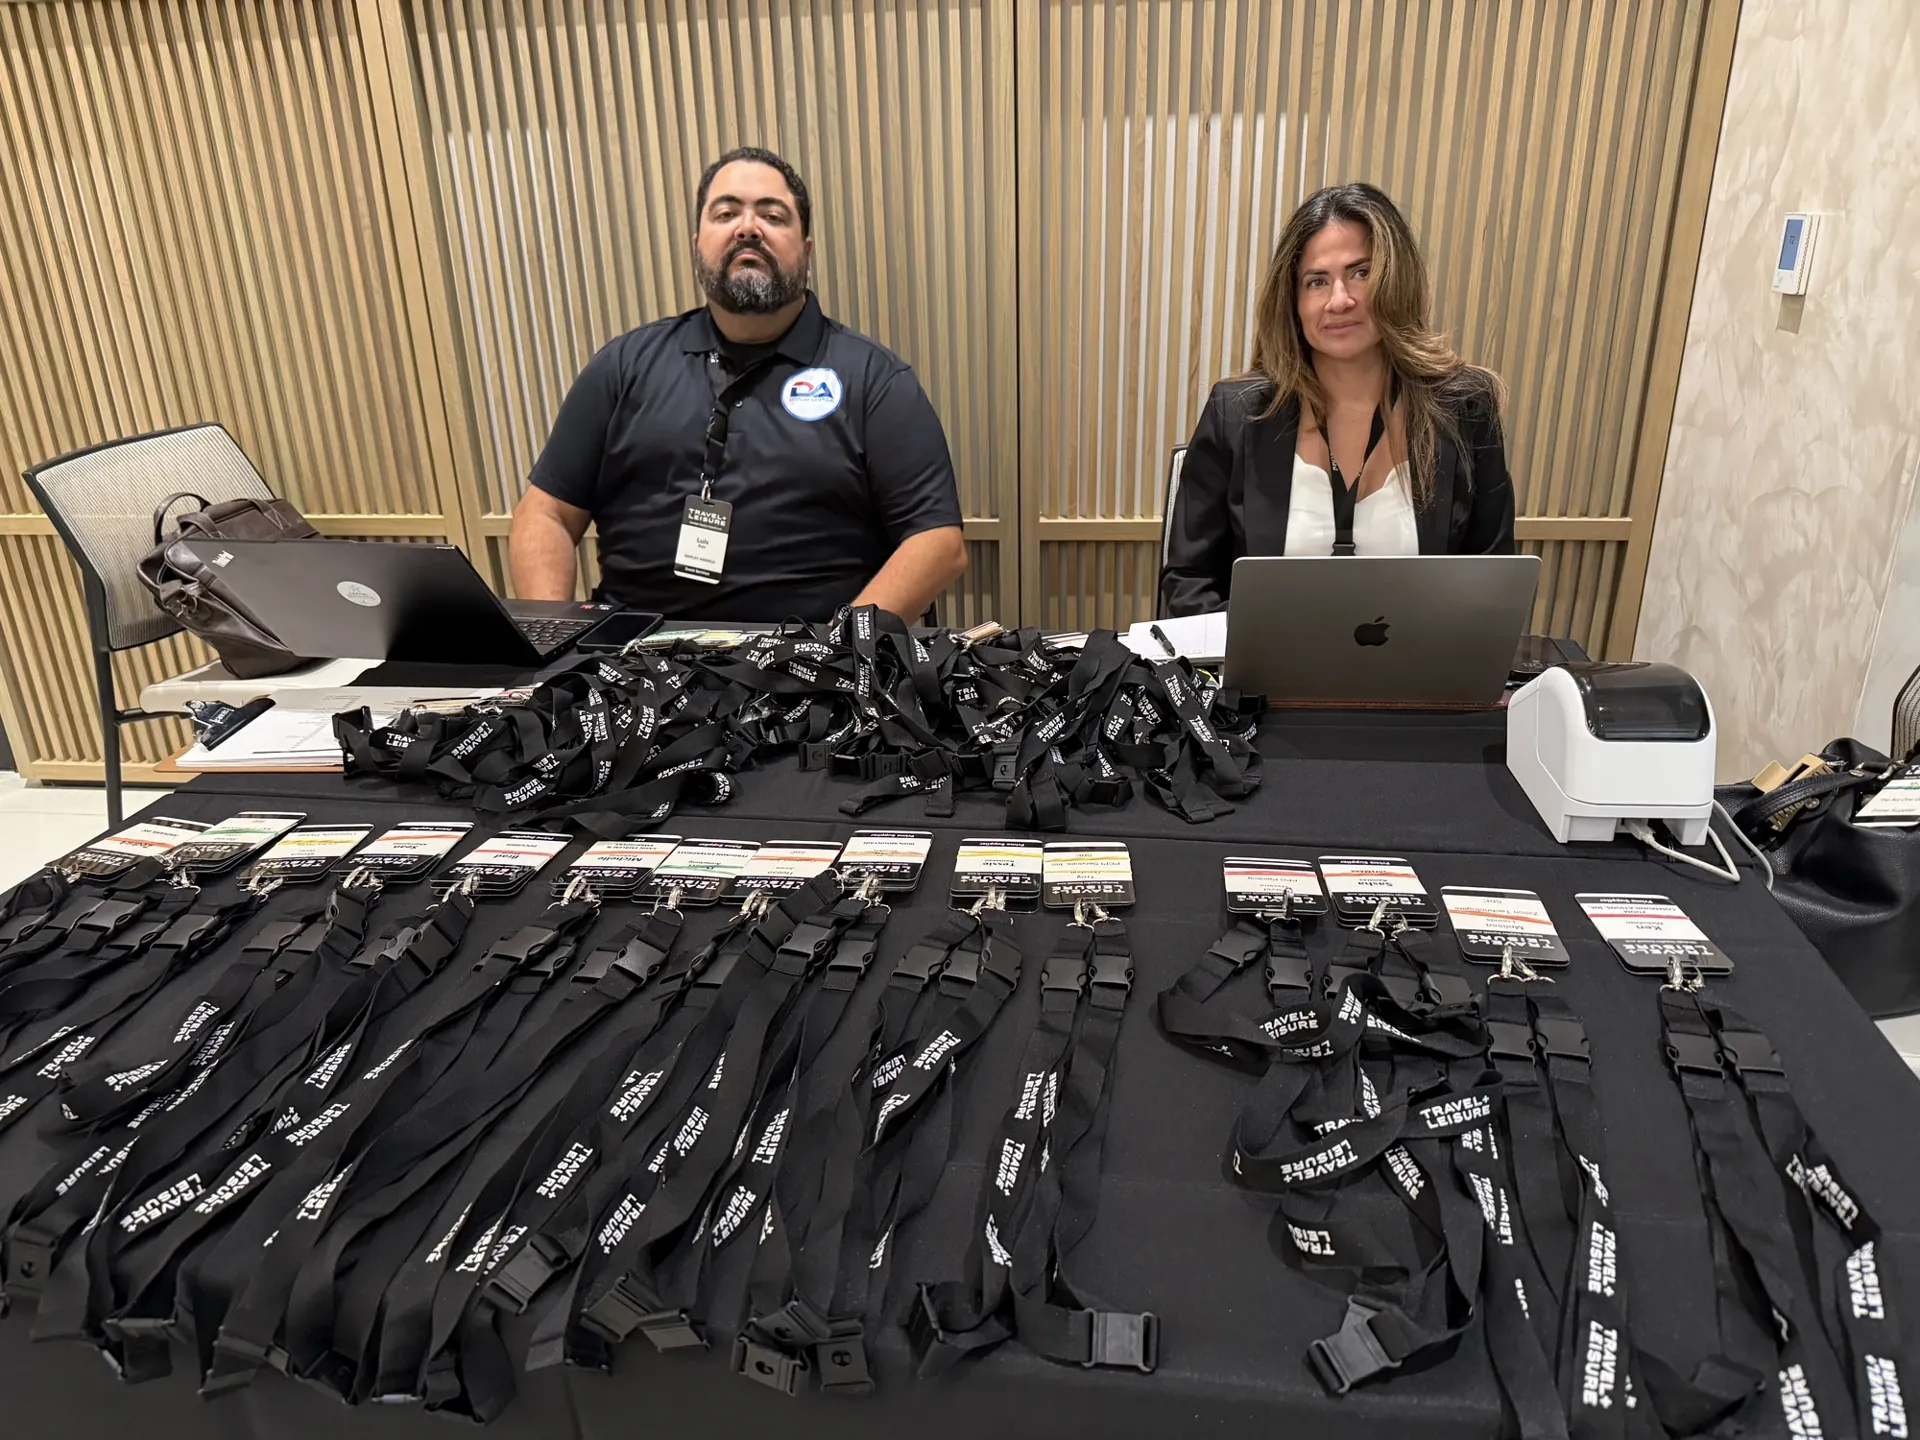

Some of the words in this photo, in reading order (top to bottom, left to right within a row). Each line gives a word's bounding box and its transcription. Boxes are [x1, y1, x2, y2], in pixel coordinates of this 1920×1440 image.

[688, 514, 726, 526] LEISURE
[689, 508, 726, 520] TRAVEL+
[857, 612, 866, 640] LEISURE
[788, 668, 816, 682] LEISURE
[789, 660, 818, 676] TRAVEL+
[1164, 678, 1182, 707] LEISURE
[450, 720, 488, 756] LEISURE
[457, 722, 494, 760] TRAVEL+
[1036, 712, 1064, 739] LEISURE
[506, 781, 546, 806] TRAVEL+
[1466, 934, 1550, 945] LEISURE
[1469, 939, 1555, 950] TRAVEL+
[1622, 944, 1708, 952] LEISURE
[1627, 948, 1714, 956] TRAVEL+
[173, 1000, 212, 1044] LEISURE
[184, 1004, 220, 1042] TRAVEL+
[200, 1020, 236, 1067] TRAVEL+
[1269, 1020, 1318, 1040] EISURE
[37, 1036, 84, 1078] TRAVEL+
[913, 1030, 952, 1069] LEISURE
[924, 1034, 962, 1072] TRAVEL+
[610, 1072, 656, 1118] LEISURE
[620, 1070, 664, 1122] TRAVEL+
[1014, 1073, 1038, 1120] LEISURE
[1025, 1071, 1046, 1122] TRAVEL+
[1420, 1094, 1490, 1121] TRAVEL+
[1426, 1104, 1492, 1130] LEISURE
[286, 1102, 342, 1144] LEISURE
[295, 1103, 352, 1148] TRAVEL+
[674, 1106, 704, 1152] LEISURE
[752, 1114, 780, 1164] TRAVEL+
[762, 1108, 790, 1166] LEISURE
[55, 1145, 112, 1198] LEISURE
[536, 1141, 584, 1196] LEISURE
[548, 1147, 594, 1200] TRAVEL+
[995, 1138, 1016, 1190] LEISURE
[1004, 1142, 1026, 1196] TRAVEL+
[1280, 1138, 1352, 1176] LEISURE
[1283, 1150, 1358, 1184] TRAVEL+
[1384, 1149, 1420, 1200] LEISURE
[1394, 1144, 1426, 1190] TRAVEL+
[119, 1172, 200, 1229] LEISURE
[194, 1153, 263, 1214] LEISURE
[203, 1160, 272, 1215] TRAVEL+
[126, 1183, 206, 1234] TRAVEL+
[598, 1193, 638, 1248] LEISURE
[603, 1202, 648, 1255] TRAVEL+
[711, 1185, 748, 1236] TRAVEL+
[713, 1190, 758, 1248] LEISURE
[1588, 1221, 1604, 1294] LEISURE
[1602, 1229, 1616, 1297] TRAVEL+
[1582, 1320, 1604, 1408] LEISURE
[1599, 1328, 1618, 1410] TRAVEL+
[1864, 1354, 1891, 1436] TRAVEL+
[1878, 1357, 1909, 1440] LEISURE
